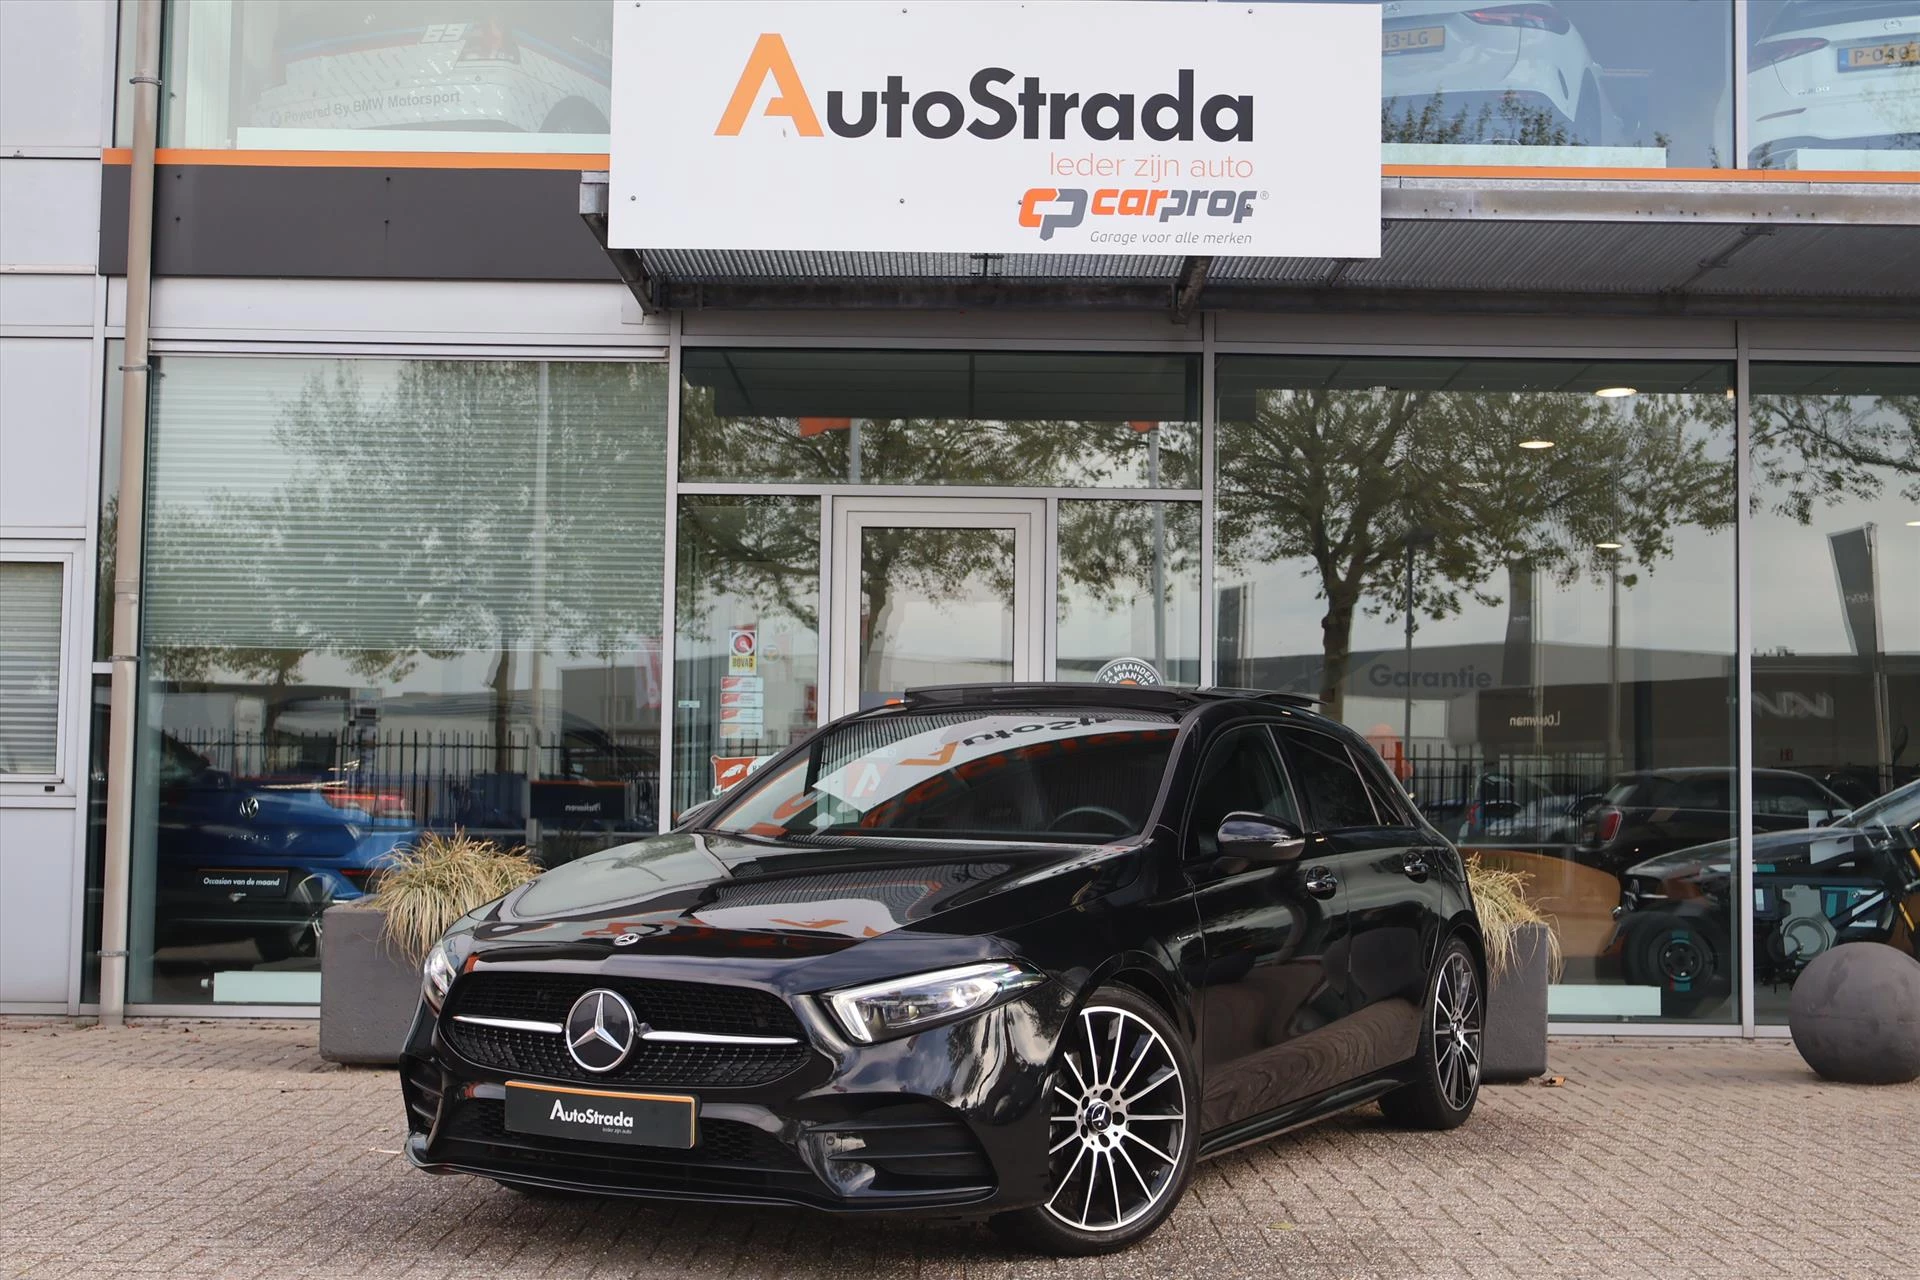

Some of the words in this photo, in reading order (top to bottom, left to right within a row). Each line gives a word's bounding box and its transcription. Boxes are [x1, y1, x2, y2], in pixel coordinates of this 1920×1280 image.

[422, 24, 464, 42] 69
[713, 33, 1254, 142] AutoStrada
[284, 104, 331, 122] Powered
[335, 102, 350, 117] By
[353, 98, 385, 113] BMW
[387, 92, 461, 109] Motorsport
[1049, 152, 1126, 177] Ieder
[1133, 154, 1181, 183] zijn
[1189, 156, 1254, 178] auto
[1090, 230, 1139, 246] Garage
[1142, 232, 1171, 244] voor
[1175, 231, 1200, 244] alle
[1203, 231, 1253, 245] merken
[1102, 670, 1113, 682] 24
[1113, 663, 1156, 684] MAANDEN
[1368, 663, 1493, 688] Garantie
[203, 876, 232, 885] Occasion
[246, 877, 255, 886] de
[256, 878, 281, 886] maand
[549, 1098, 634, 1128] AutoStrada
